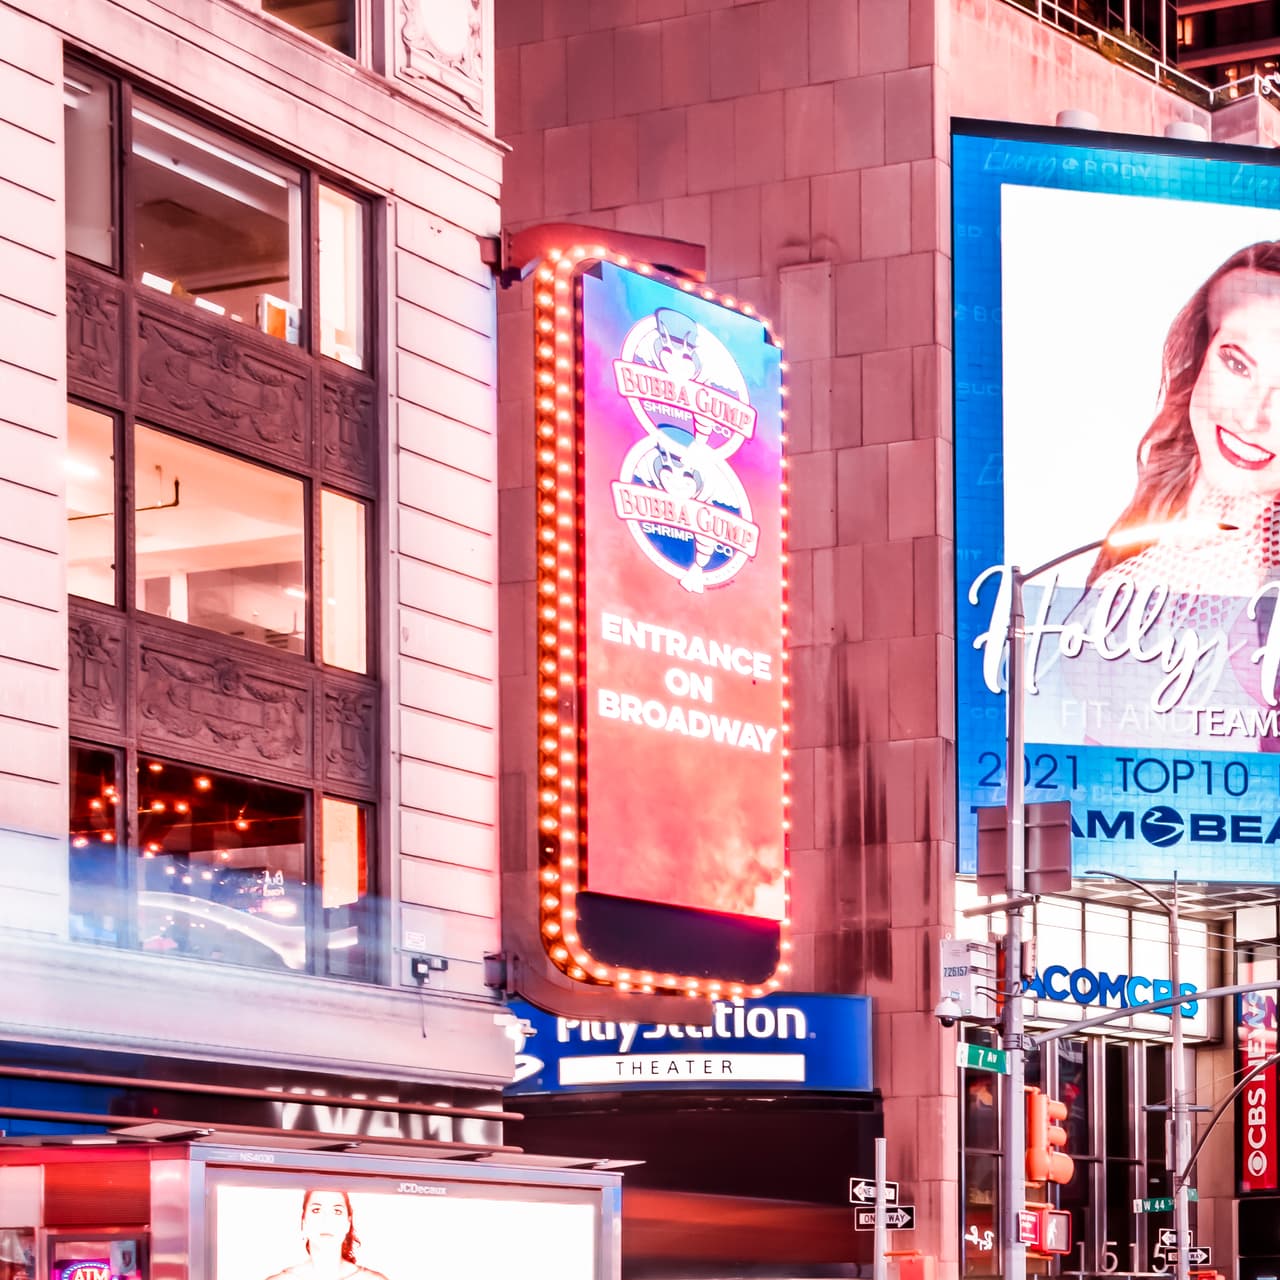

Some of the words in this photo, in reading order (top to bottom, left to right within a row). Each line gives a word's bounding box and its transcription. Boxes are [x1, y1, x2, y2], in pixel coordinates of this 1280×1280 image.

[620, 366, 691, 406] BUBBA
[695, 388, 753, 430] GUMP
[643, 401, 693, 422] SHRIMP
[619, 487, 691, 527] BUBBA
[696, 506, 755, 550] GUMP
[641, 523, 694, 543] SHRIMP
[601, 612, 772, 681] ENTRANCE
[969, 564, 1202, 713] Holly
[664, 667, 713, 703] ON
[598, 688, 778, 753] BROADWAY
[1190, 706, 1279, 739] TEAM
[1022, 965, 1199, 1019] ACOMCBS
[615, 1060, 734, 1076] THEATER
[978, 1049, 985, 1068] 7
[1247, 1087, 1267, 1150] CBS
[397, 1183, 447, 1195] JCDecaux
[1143, 1200, 1151, 1210] W
[1154, 1199, 1165, 1210] 44
[864, 1214, 875, 1222] ON
[888, 1214, 905, 1223] WAY
